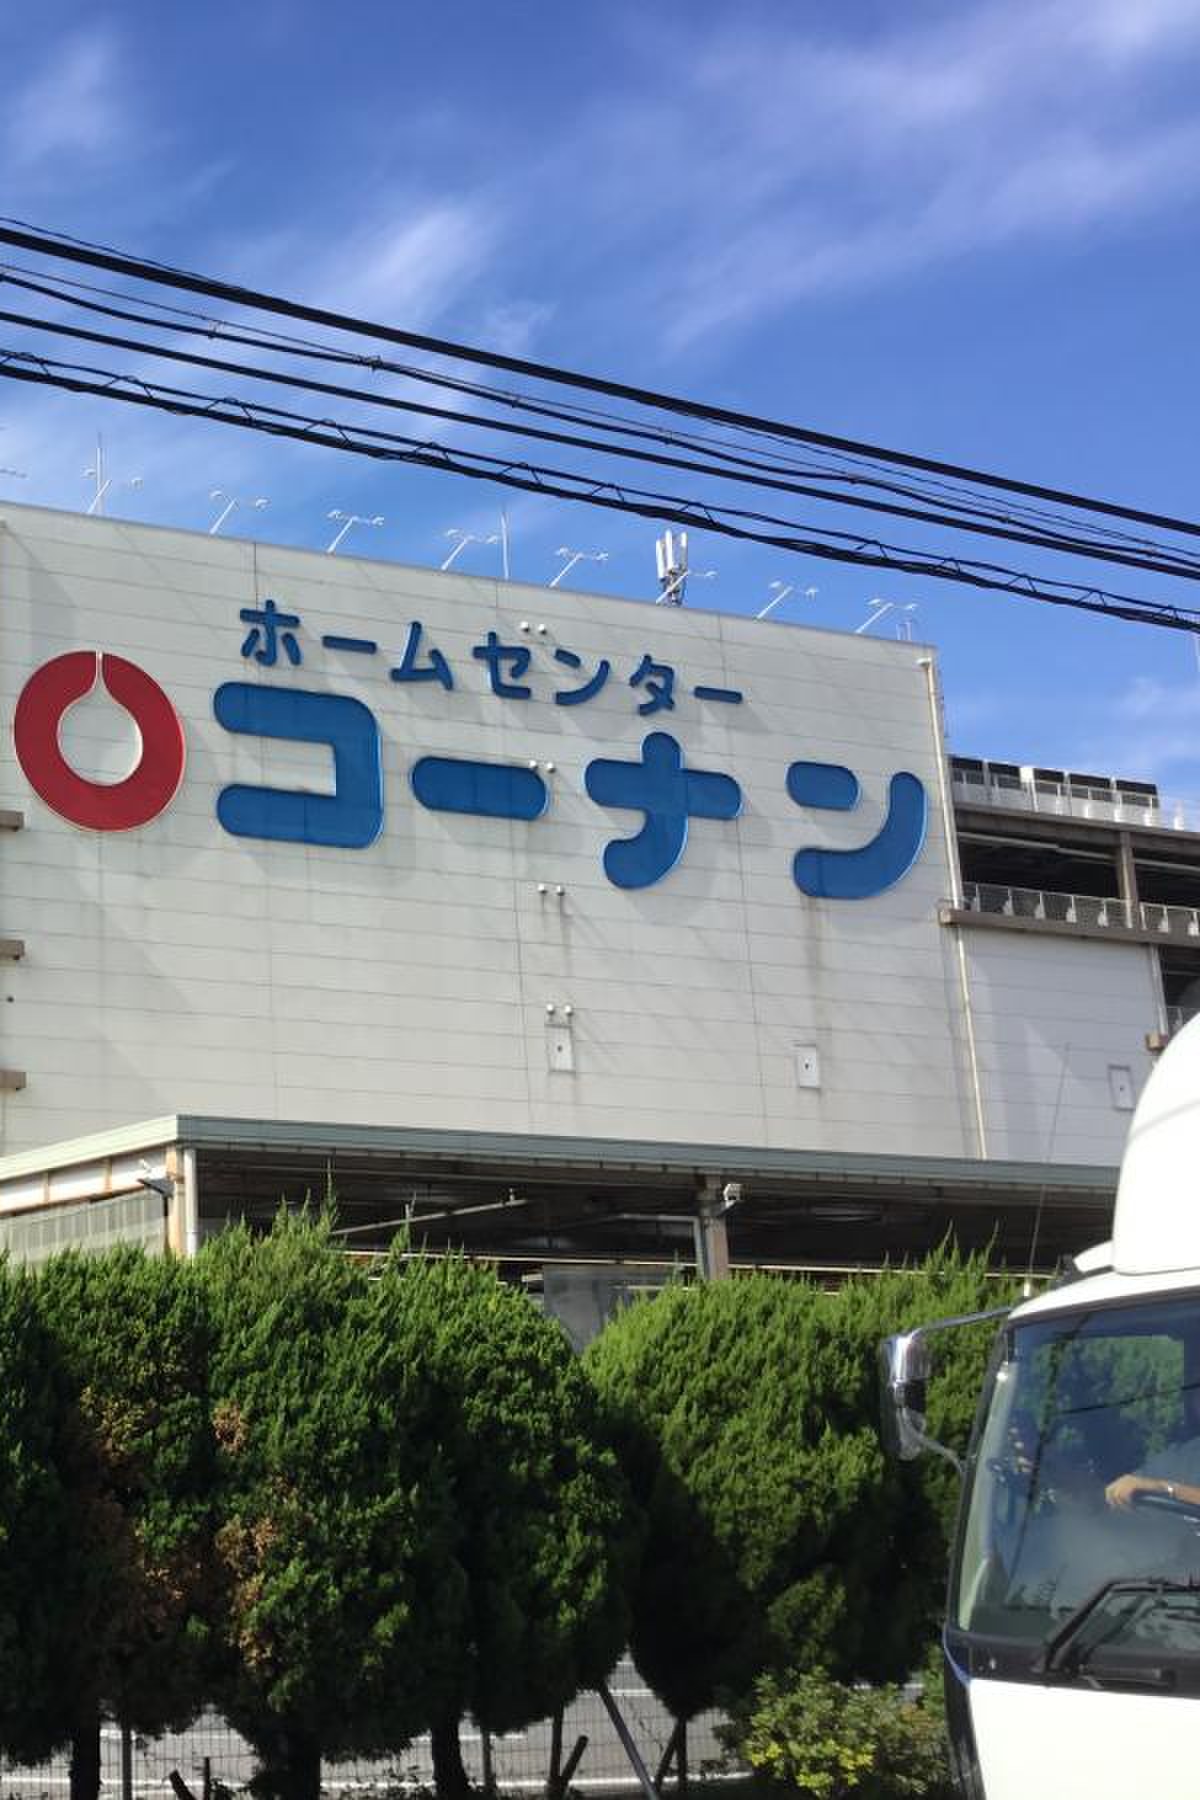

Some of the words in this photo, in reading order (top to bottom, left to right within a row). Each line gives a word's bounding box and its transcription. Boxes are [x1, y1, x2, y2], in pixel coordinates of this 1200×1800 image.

[240, 599, 743, 716] ホームセンター
[213, 681, 928, 900] コーナン
